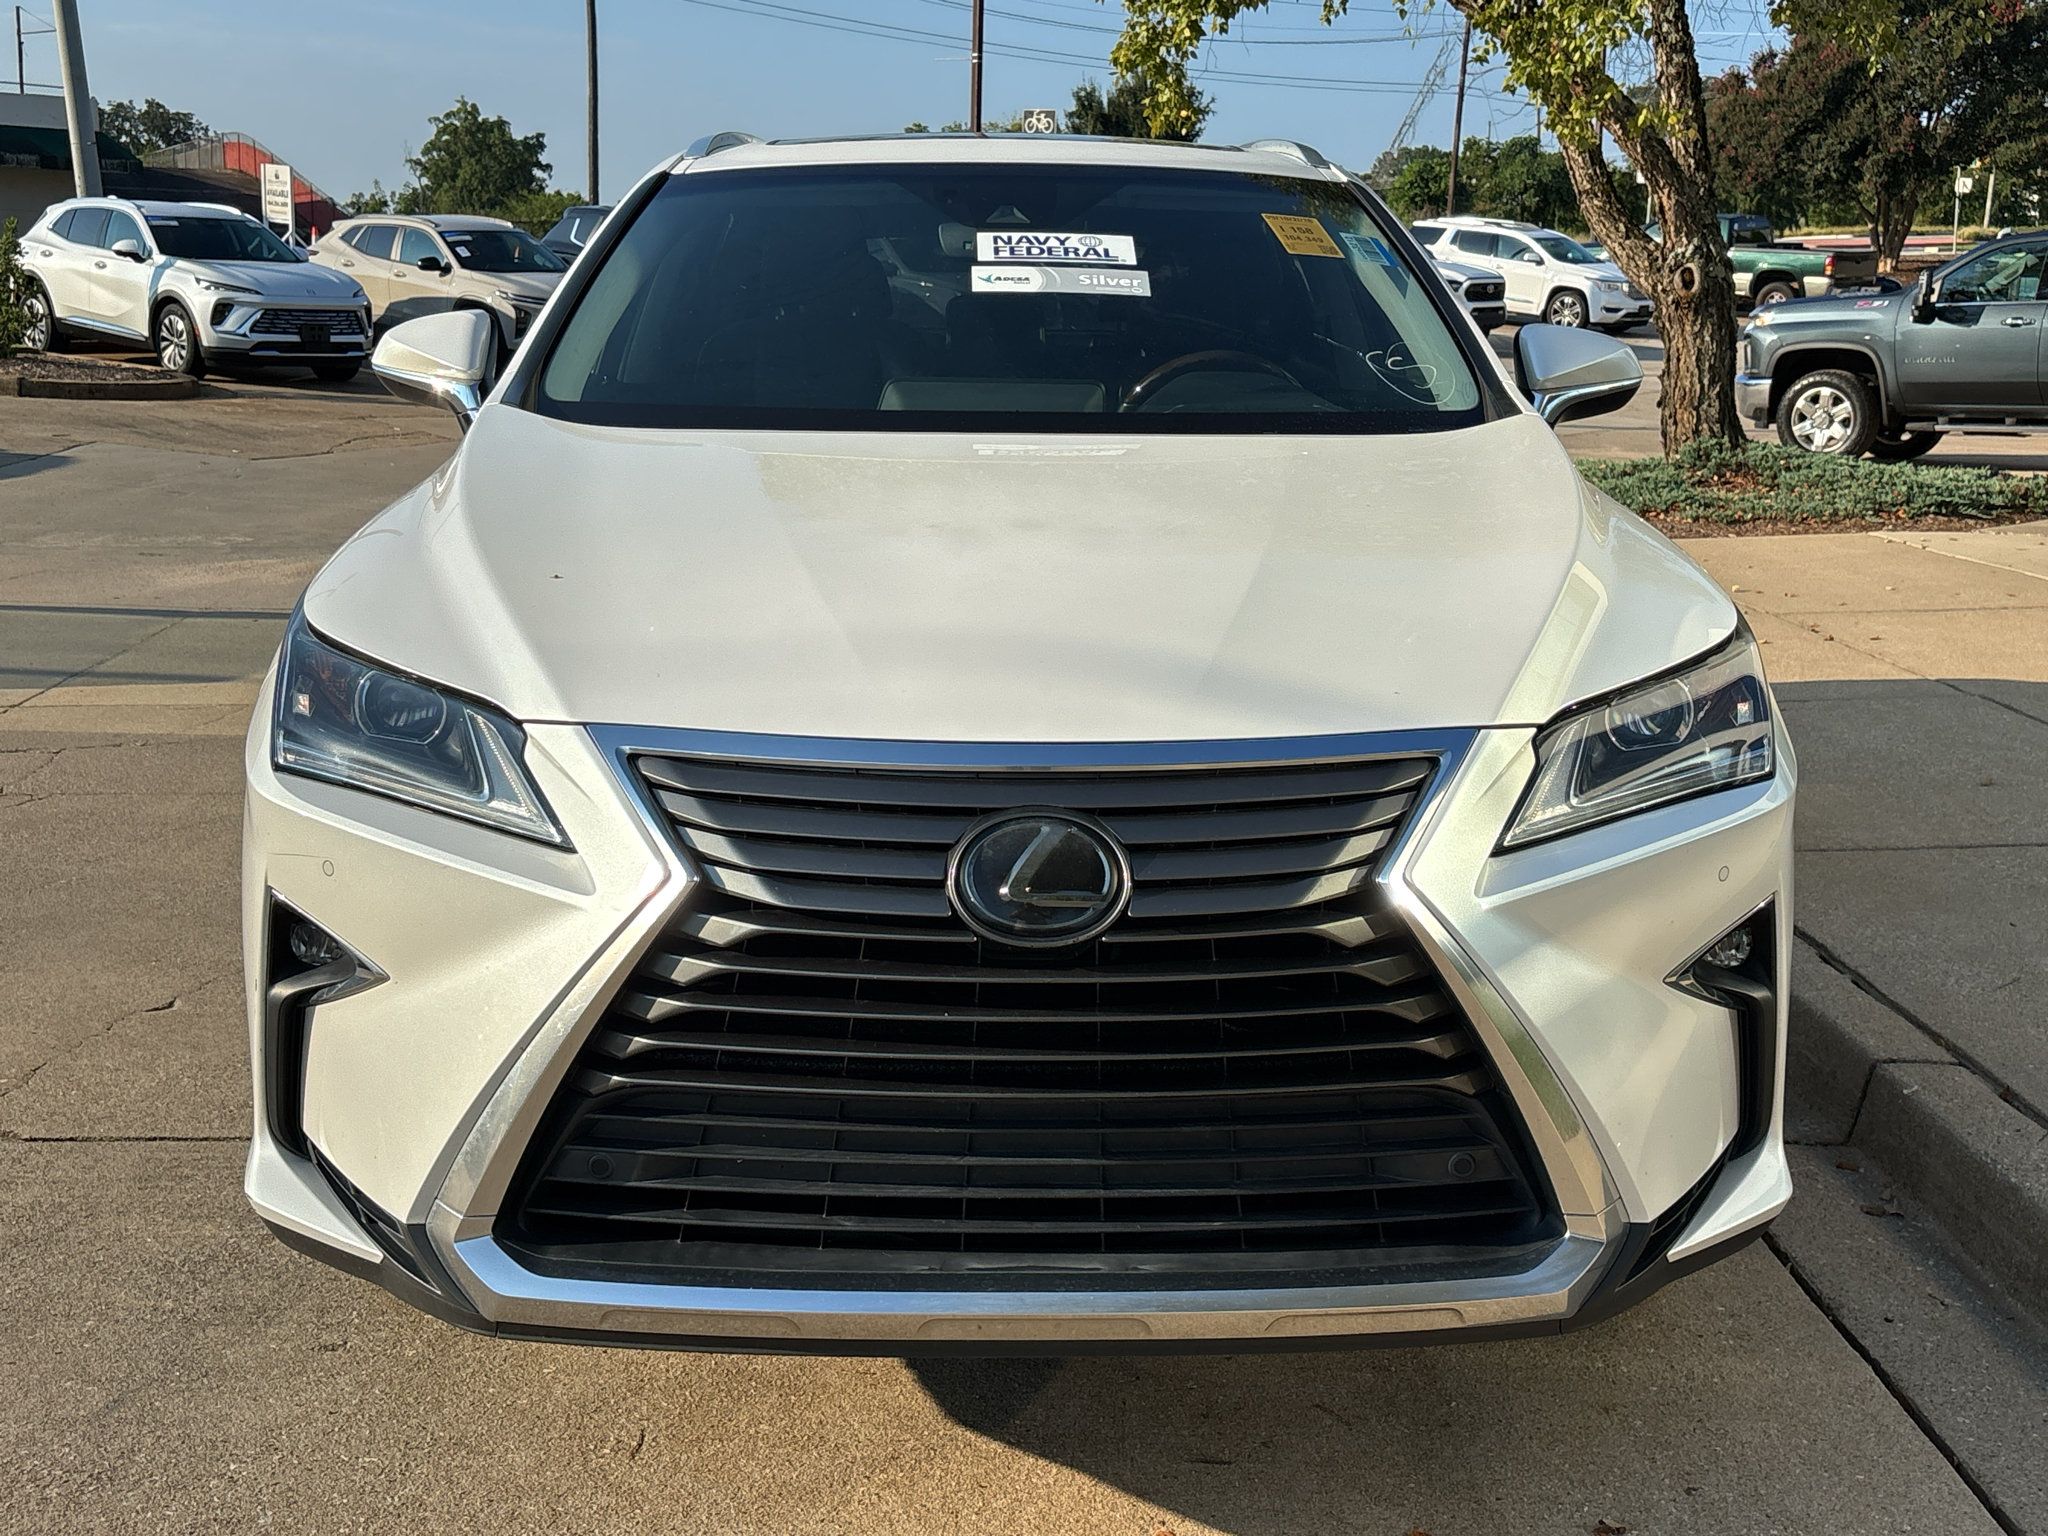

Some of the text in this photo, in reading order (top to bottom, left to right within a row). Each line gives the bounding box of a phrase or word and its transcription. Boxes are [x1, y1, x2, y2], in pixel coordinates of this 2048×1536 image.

[993, 235, 1071, 247] NAVY
[993, 245, 1119, 259] FEDERAL
[1079, 274, 1142, 287] Silver
